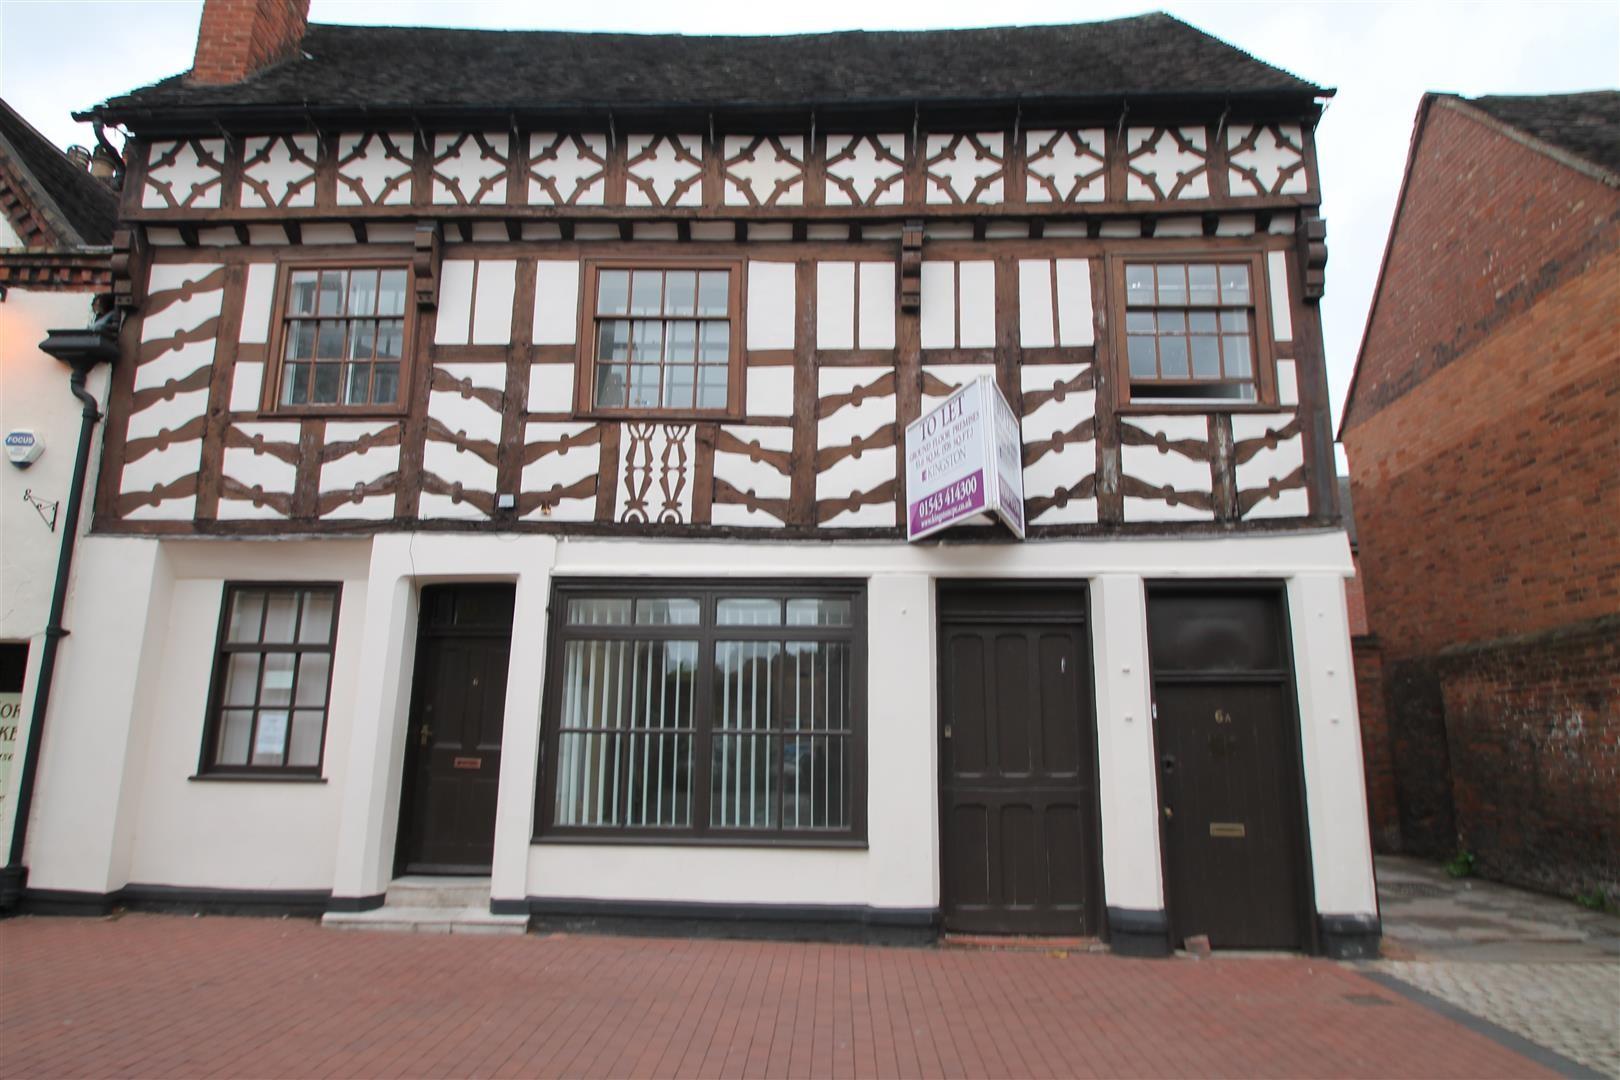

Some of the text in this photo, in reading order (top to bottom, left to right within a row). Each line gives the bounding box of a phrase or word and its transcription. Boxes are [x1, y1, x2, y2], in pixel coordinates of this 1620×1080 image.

[919, 415, 937, 441] TO
[941, 392, 965, 428] LET
[7, 435, 33, 445] FOCUS
[927, 444, 967, 481] KINGSTON
[919, 492, 943, 518] 01543
[944, 475, 977, 506] 414300
